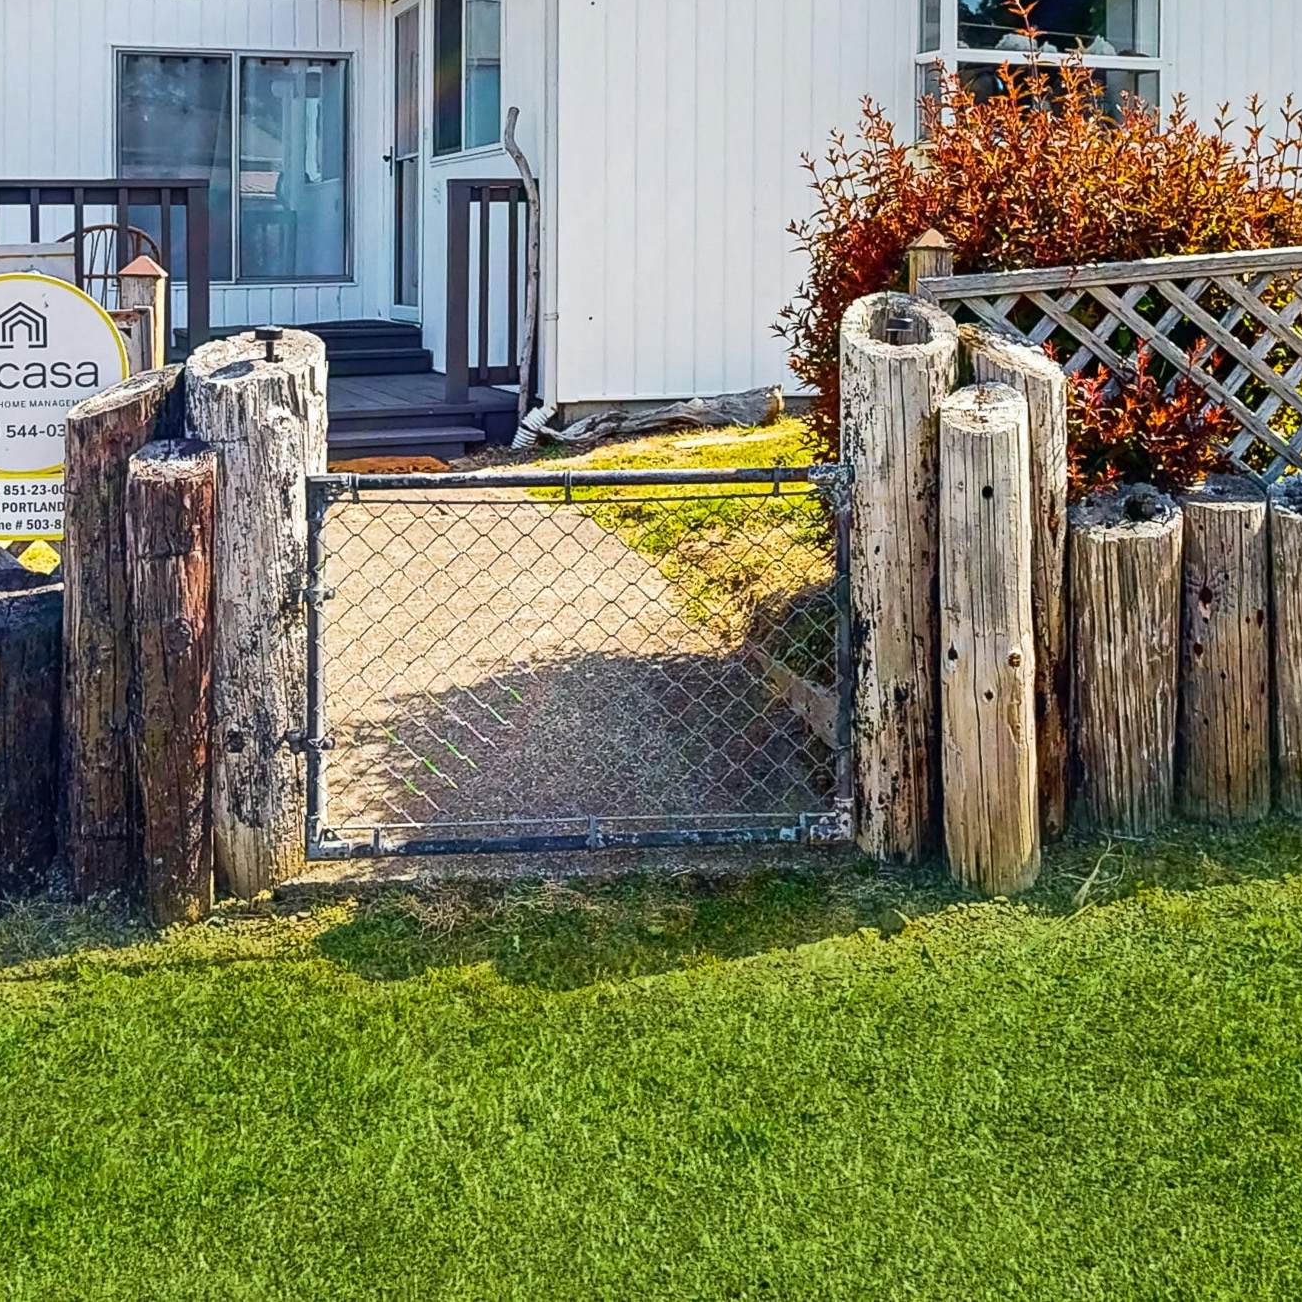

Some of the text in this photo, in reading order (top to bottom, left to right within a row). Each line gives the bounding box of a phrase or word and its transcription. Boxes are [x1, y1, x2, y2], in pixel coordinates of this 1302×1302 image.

[2, 501, 65, 513] PORTLAND
[15, 519, 23, 530] #
[26, 518, 65, 530] 503-8
